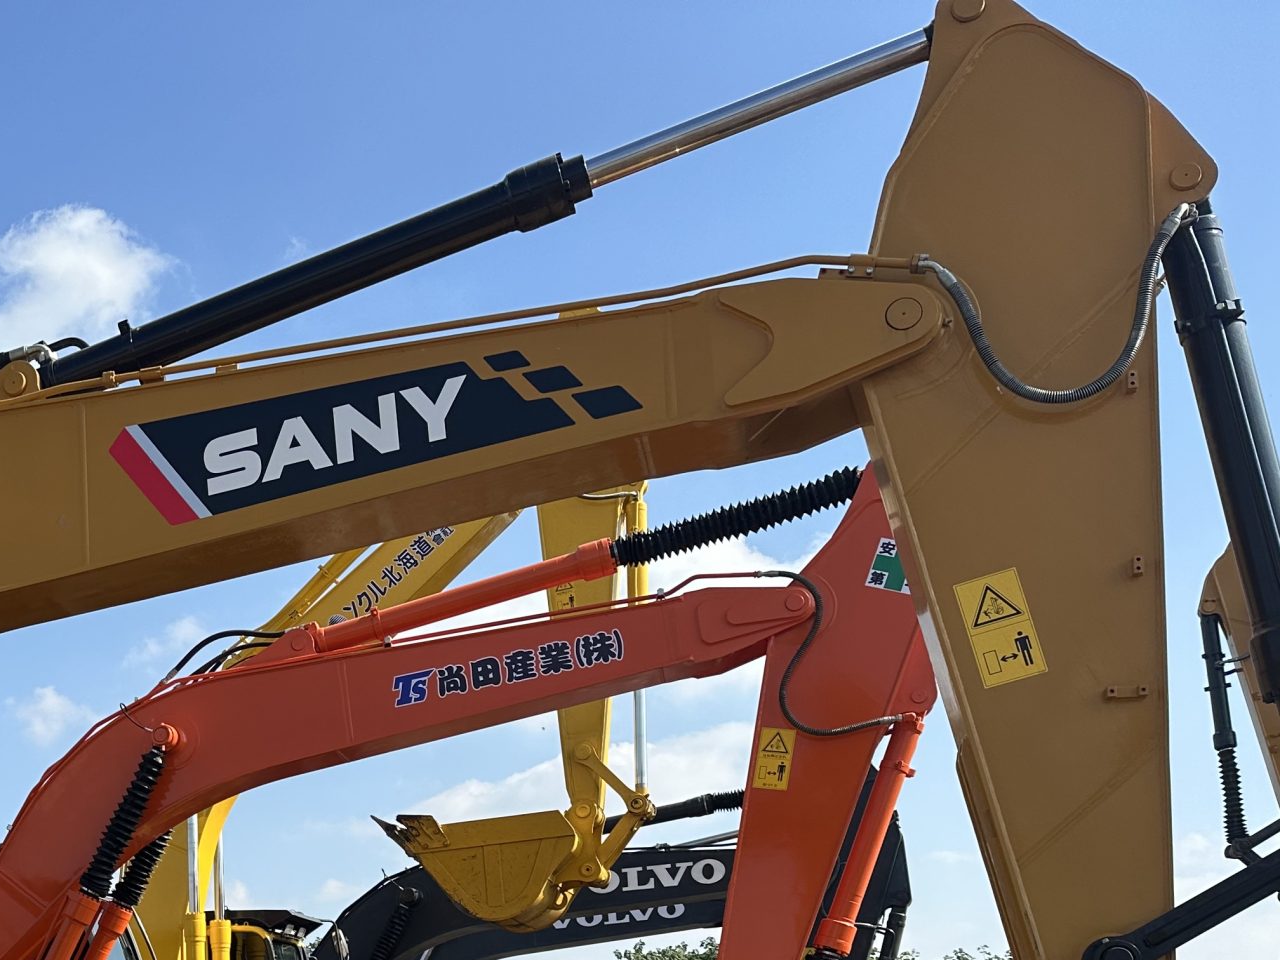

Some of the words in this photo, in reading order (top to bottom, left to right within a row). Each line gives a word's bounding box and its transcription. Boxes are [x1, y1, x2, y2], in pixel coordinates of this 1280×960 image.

[203, 374, 467, 496] SANY
[879, 541, 896, 556] 安
[588, 858, 726, 894] OLVO
